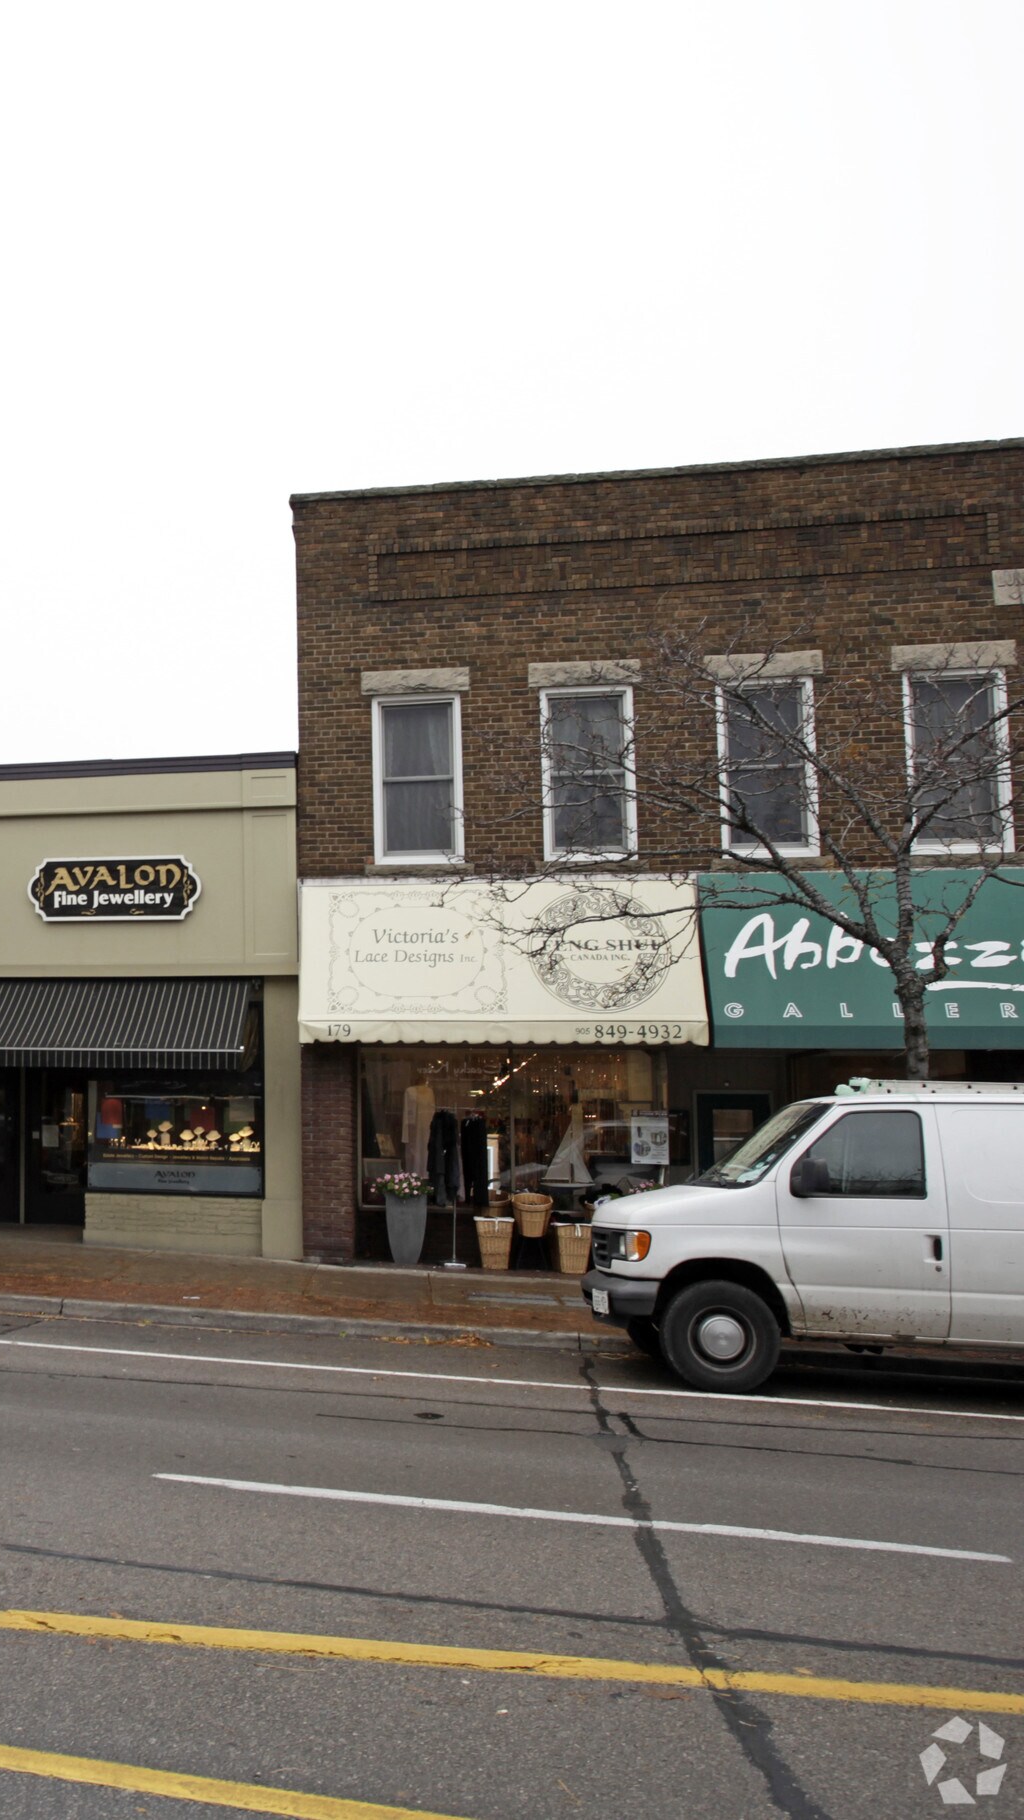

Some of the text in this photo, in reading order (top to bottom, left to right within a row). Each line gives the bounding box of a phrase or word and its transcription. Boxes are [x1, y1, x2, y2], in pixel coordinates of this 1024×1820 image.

[45, 864, 182, 896] AVALON
[53, 890, 174, 908] Fine Jewellery
[372, 928, 459, 944] Victoria's
[724, 912, 1024, 980] Abbzz
[354, 950, 388, 963] Lace
[394, 949, 454, 968] Designs
[570, 953, 608, 961] CANADA
[326, 1024, 351, 1037] 179
[575, 1024, 682, 1039] 905 849-4932
[154, 1170, 195, 1178] AVALON
